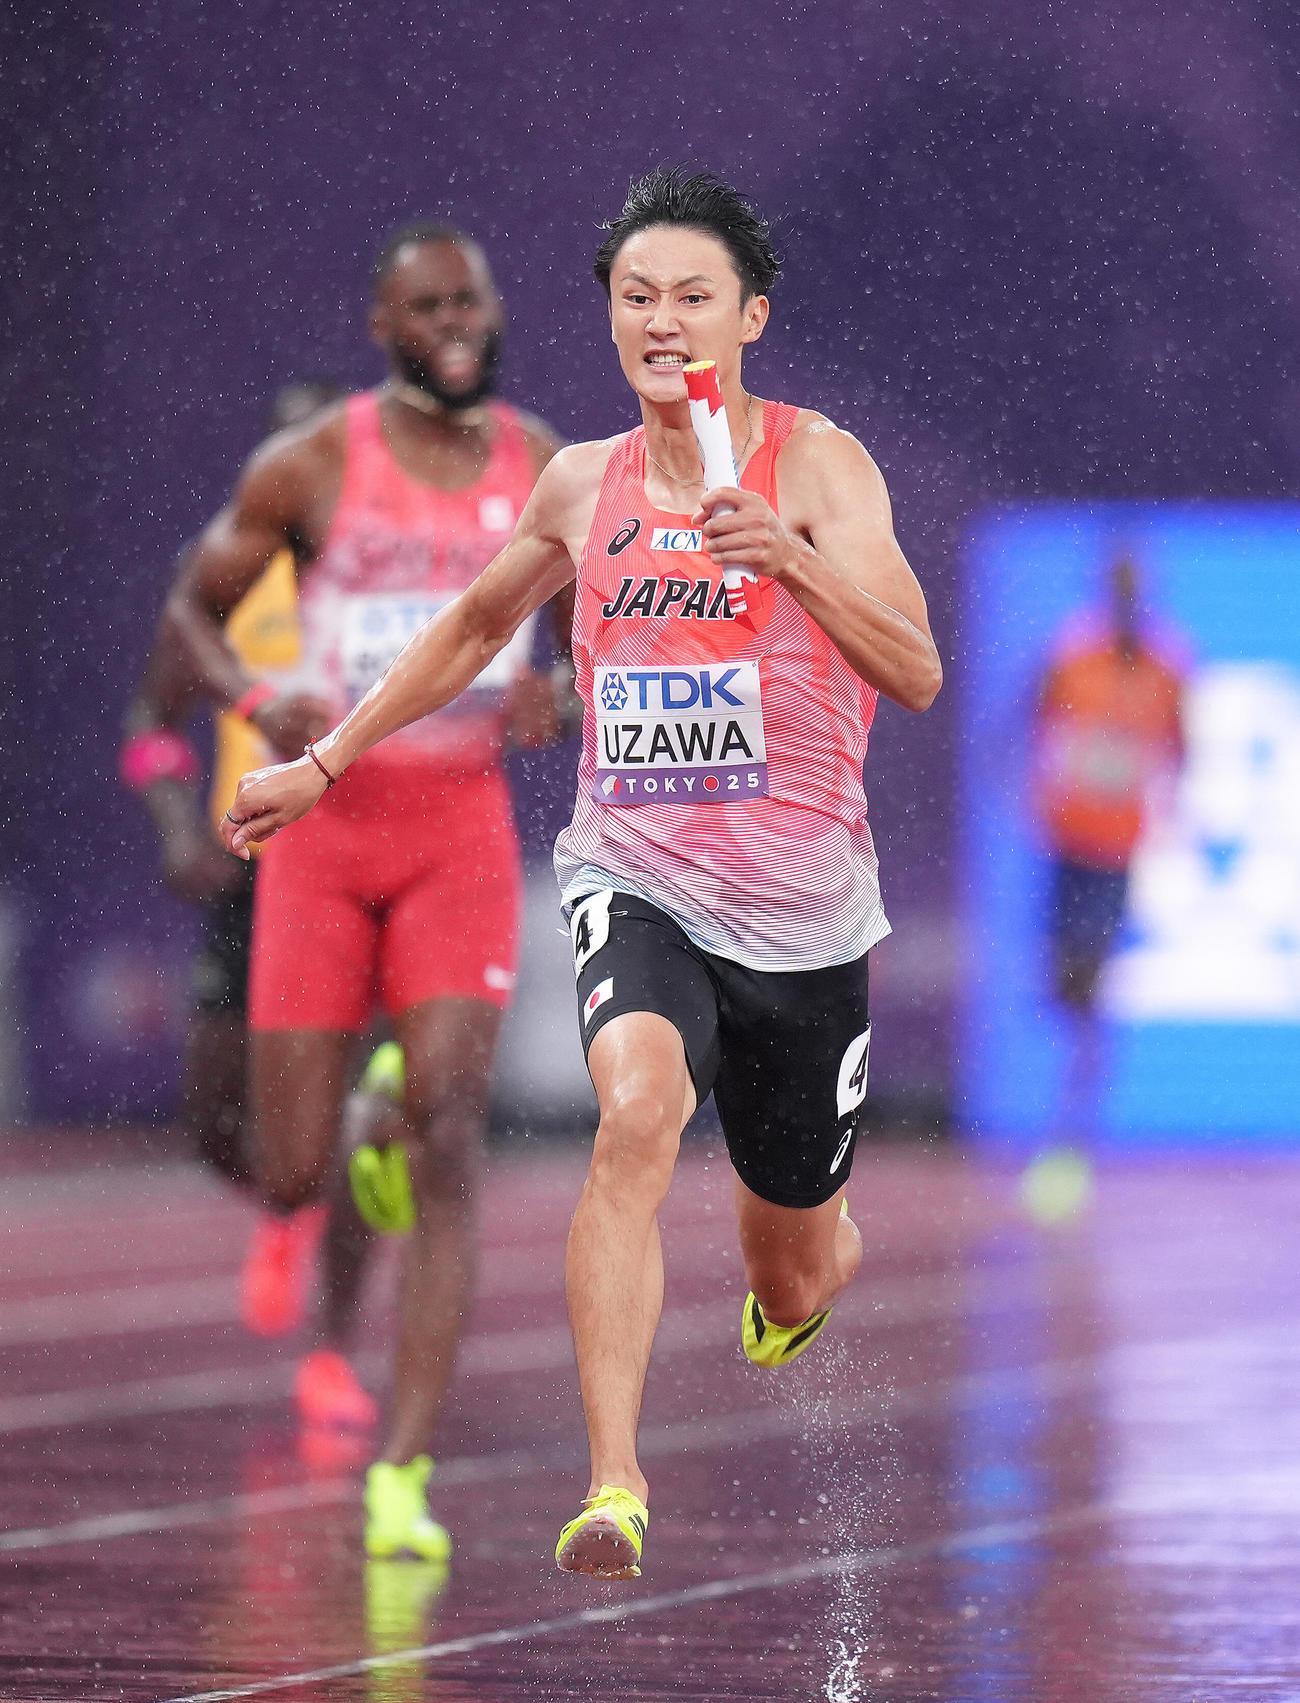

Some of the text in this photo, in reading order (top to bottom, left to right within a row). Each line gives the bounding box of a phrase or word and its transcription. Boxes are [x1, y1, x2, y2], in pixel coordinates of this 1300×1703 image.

[654, 530, 702, 550] ACN
[626, 667, 746, 710] TDK
[603, 720, 754, 764] UZAWA
[575, 908, 594, 961] 4
[848, 1040, 870, 1096] 4
